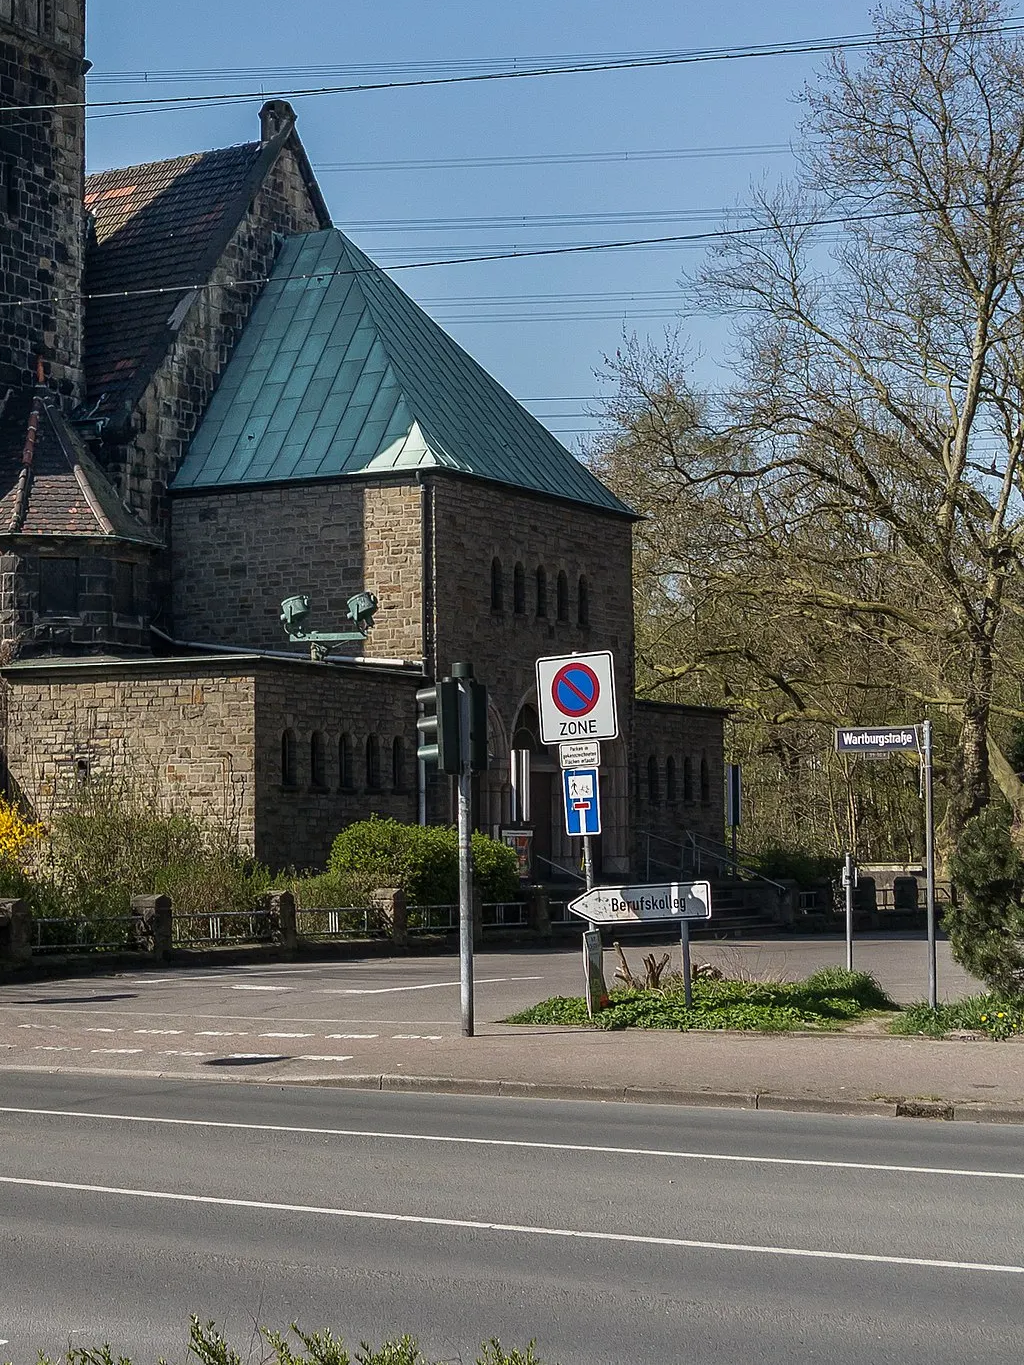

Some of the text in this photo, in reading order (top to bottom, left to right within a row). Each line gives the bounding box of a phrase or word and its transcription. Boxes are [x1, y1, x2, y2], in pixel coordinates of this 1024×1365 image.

[559, 719, 598, 736] ZONE
[842, 731, 913, 746] Wartburgstraße
[611, 895, 687, 913] Berufskolleg
